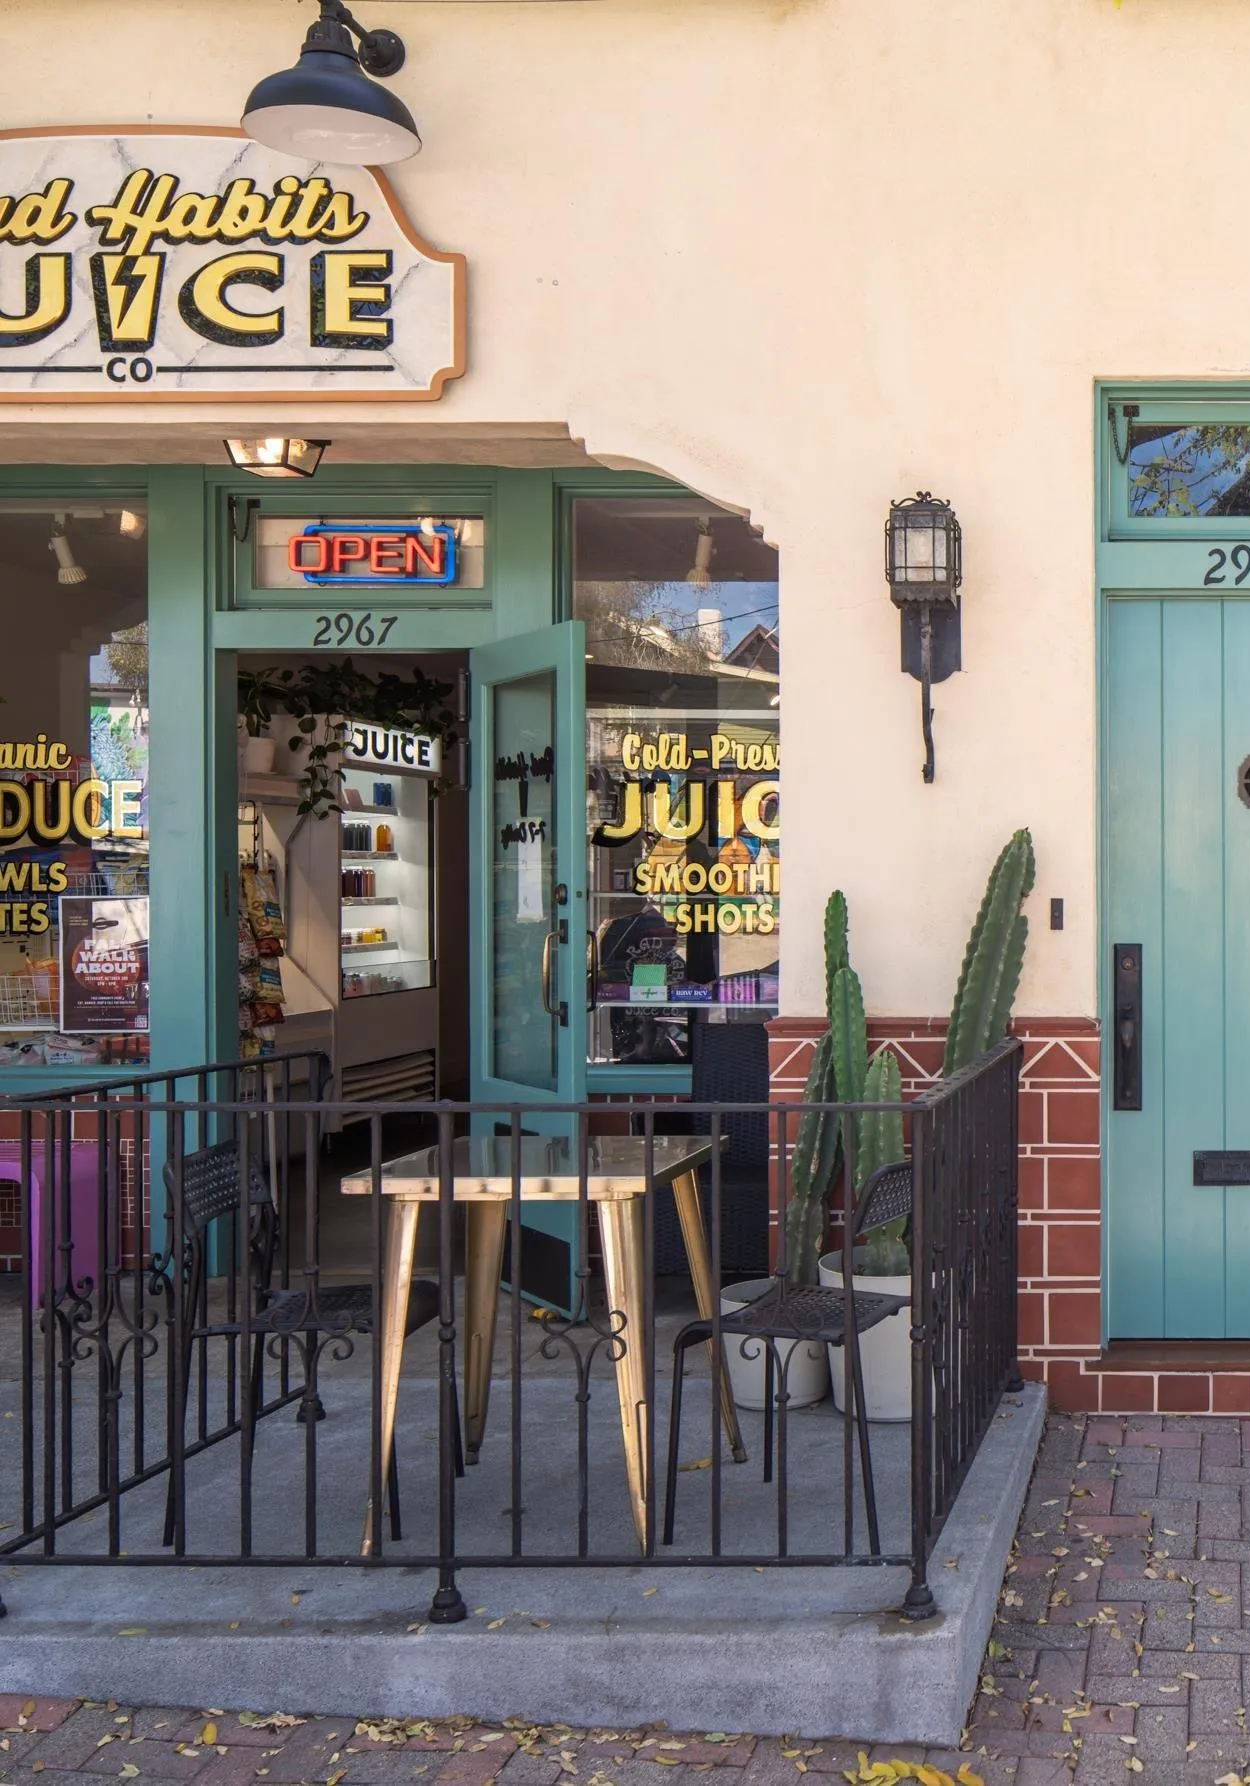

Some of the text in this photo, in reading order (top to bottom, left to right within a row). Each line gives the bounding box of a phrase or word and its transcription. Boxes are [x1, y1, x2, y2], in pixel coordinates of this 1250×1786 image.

[84, 168, 370, 250] Habits
[106, 357, 153, 382] CO
[288, 535, 444, 574] OPEN
[313, 613, 398, 646] 2967
[352, 728, 430, 767] JUICE
[0, 778, 143, 844] DUCE
[594, 780, 780, 846] JUIC
[676, 903, 775, 934] SHOTS
[74, 963, 140, 974] ABOUT
